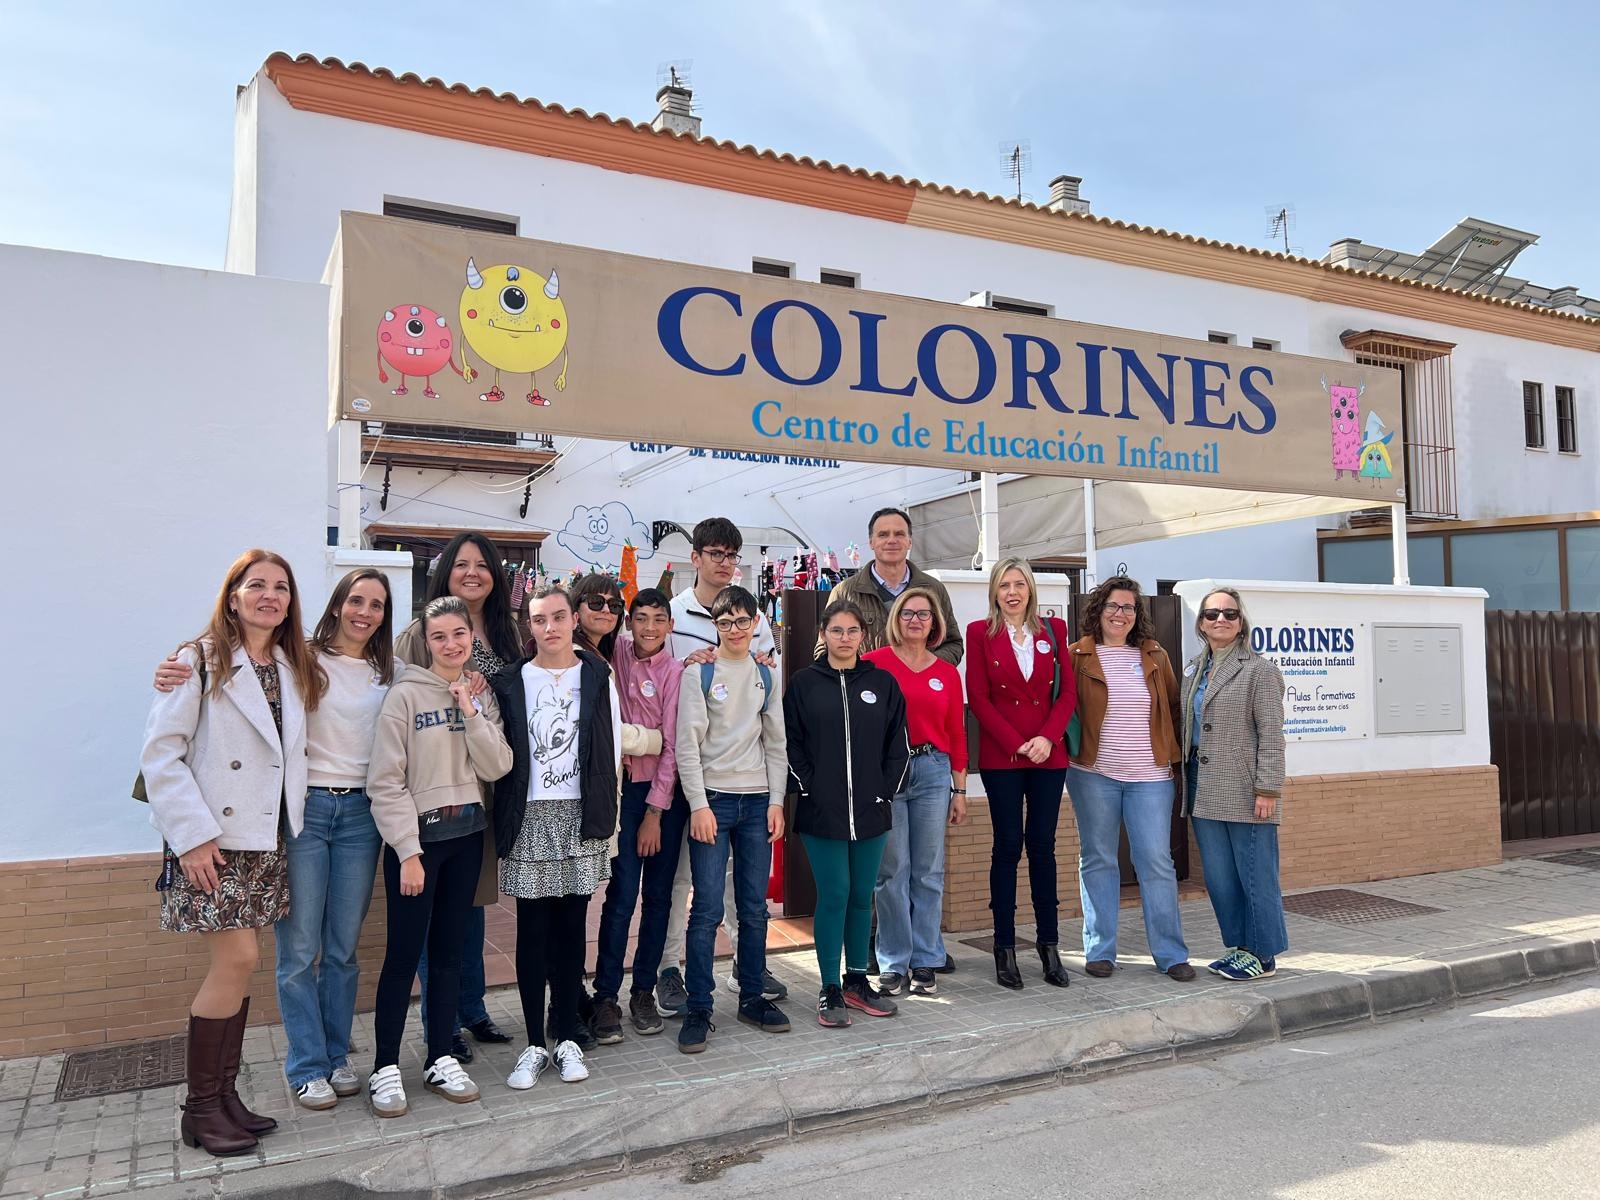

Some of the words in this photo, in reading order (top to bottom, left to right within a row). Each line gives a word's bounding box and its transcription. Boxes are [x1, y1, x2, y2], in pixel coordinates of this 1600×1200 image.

[657, 286, 1277, 436] COLORINES
[751, 400, 878, 446] Centro
[891, 412, 932, 451] de
[944, 419, 1105, 467] Educación
[1118, 434, 1221, 475] Infantil
[1250, 626, 1354, 655] OLORINES
[1280, 657, 1323, 667] Educación
[1324, 656, 1355, 667] Infantil
[1287, 685, 1311, 702] Aulas
[1315, 685, 1356, 702] Formativas
[1293, 704, 1316, 714] Empresa
[1317, 703, 1325, 711] de
[541, 759, 581, 788] Bamb
